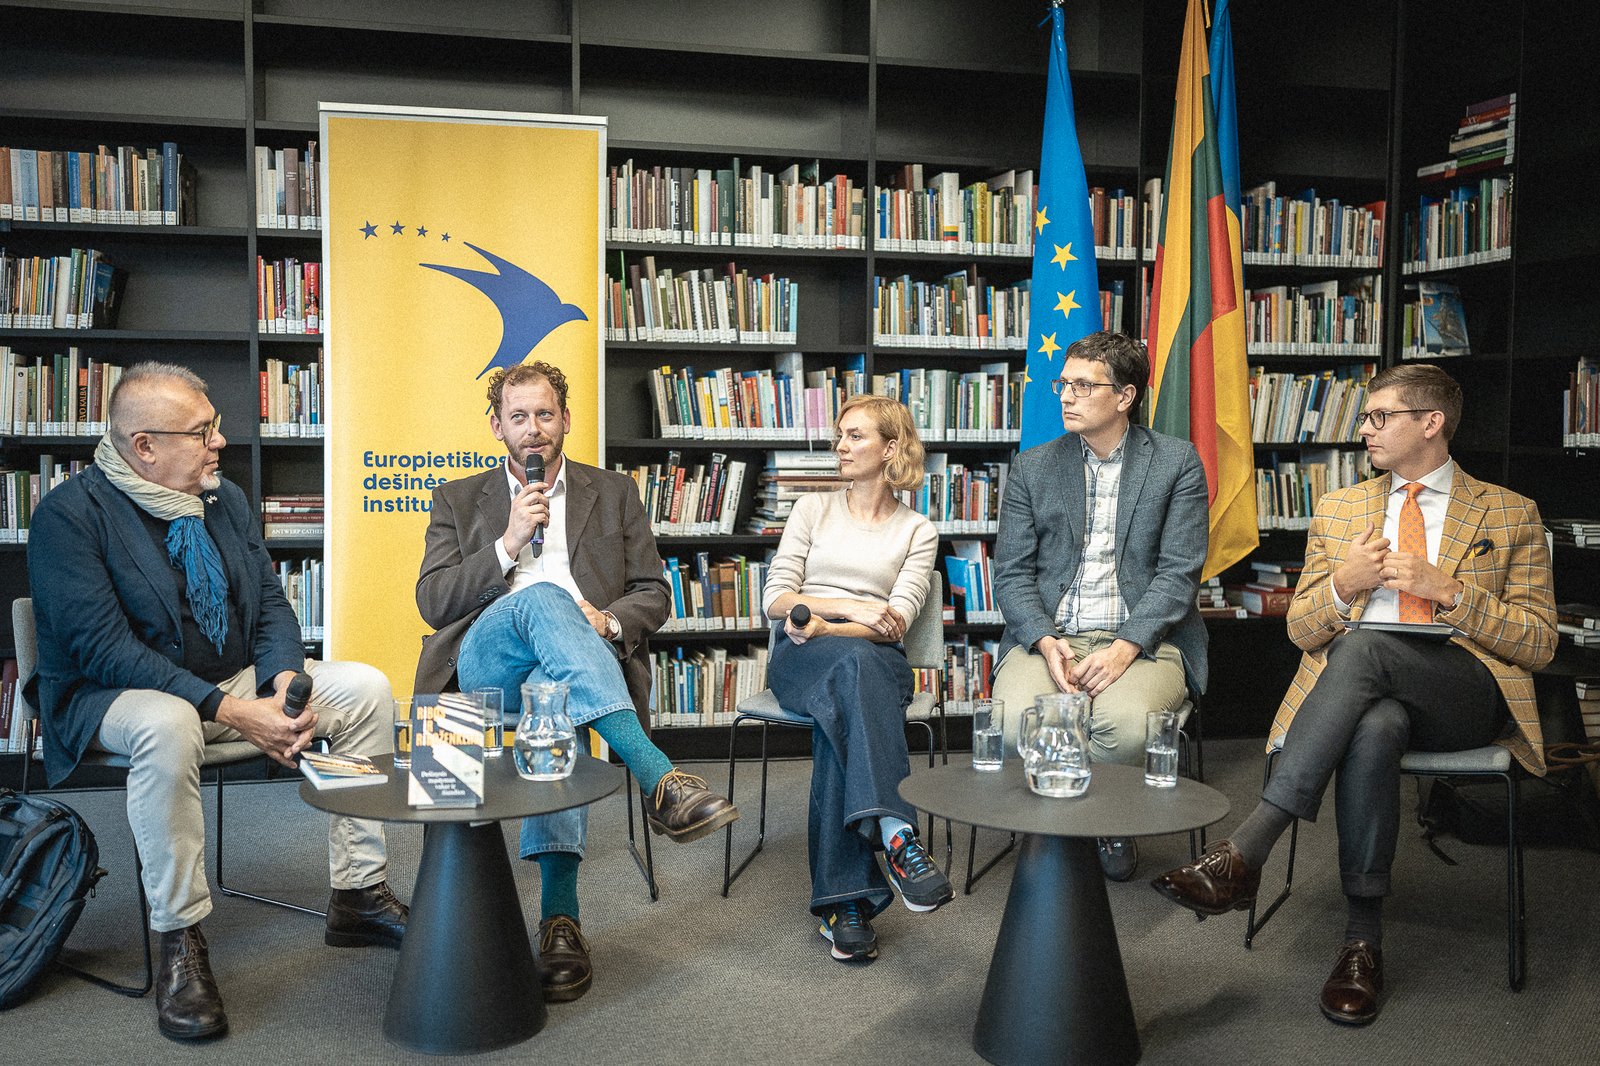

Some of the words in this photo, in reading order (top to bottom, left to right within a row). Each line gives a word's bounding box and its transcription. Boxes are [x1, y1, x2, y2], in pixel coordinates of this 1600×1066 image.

[363, 451, 506, 472] Europietiškos
[363, 473, 448, 490] dešinės
[363, 495, 433, 512] institu
